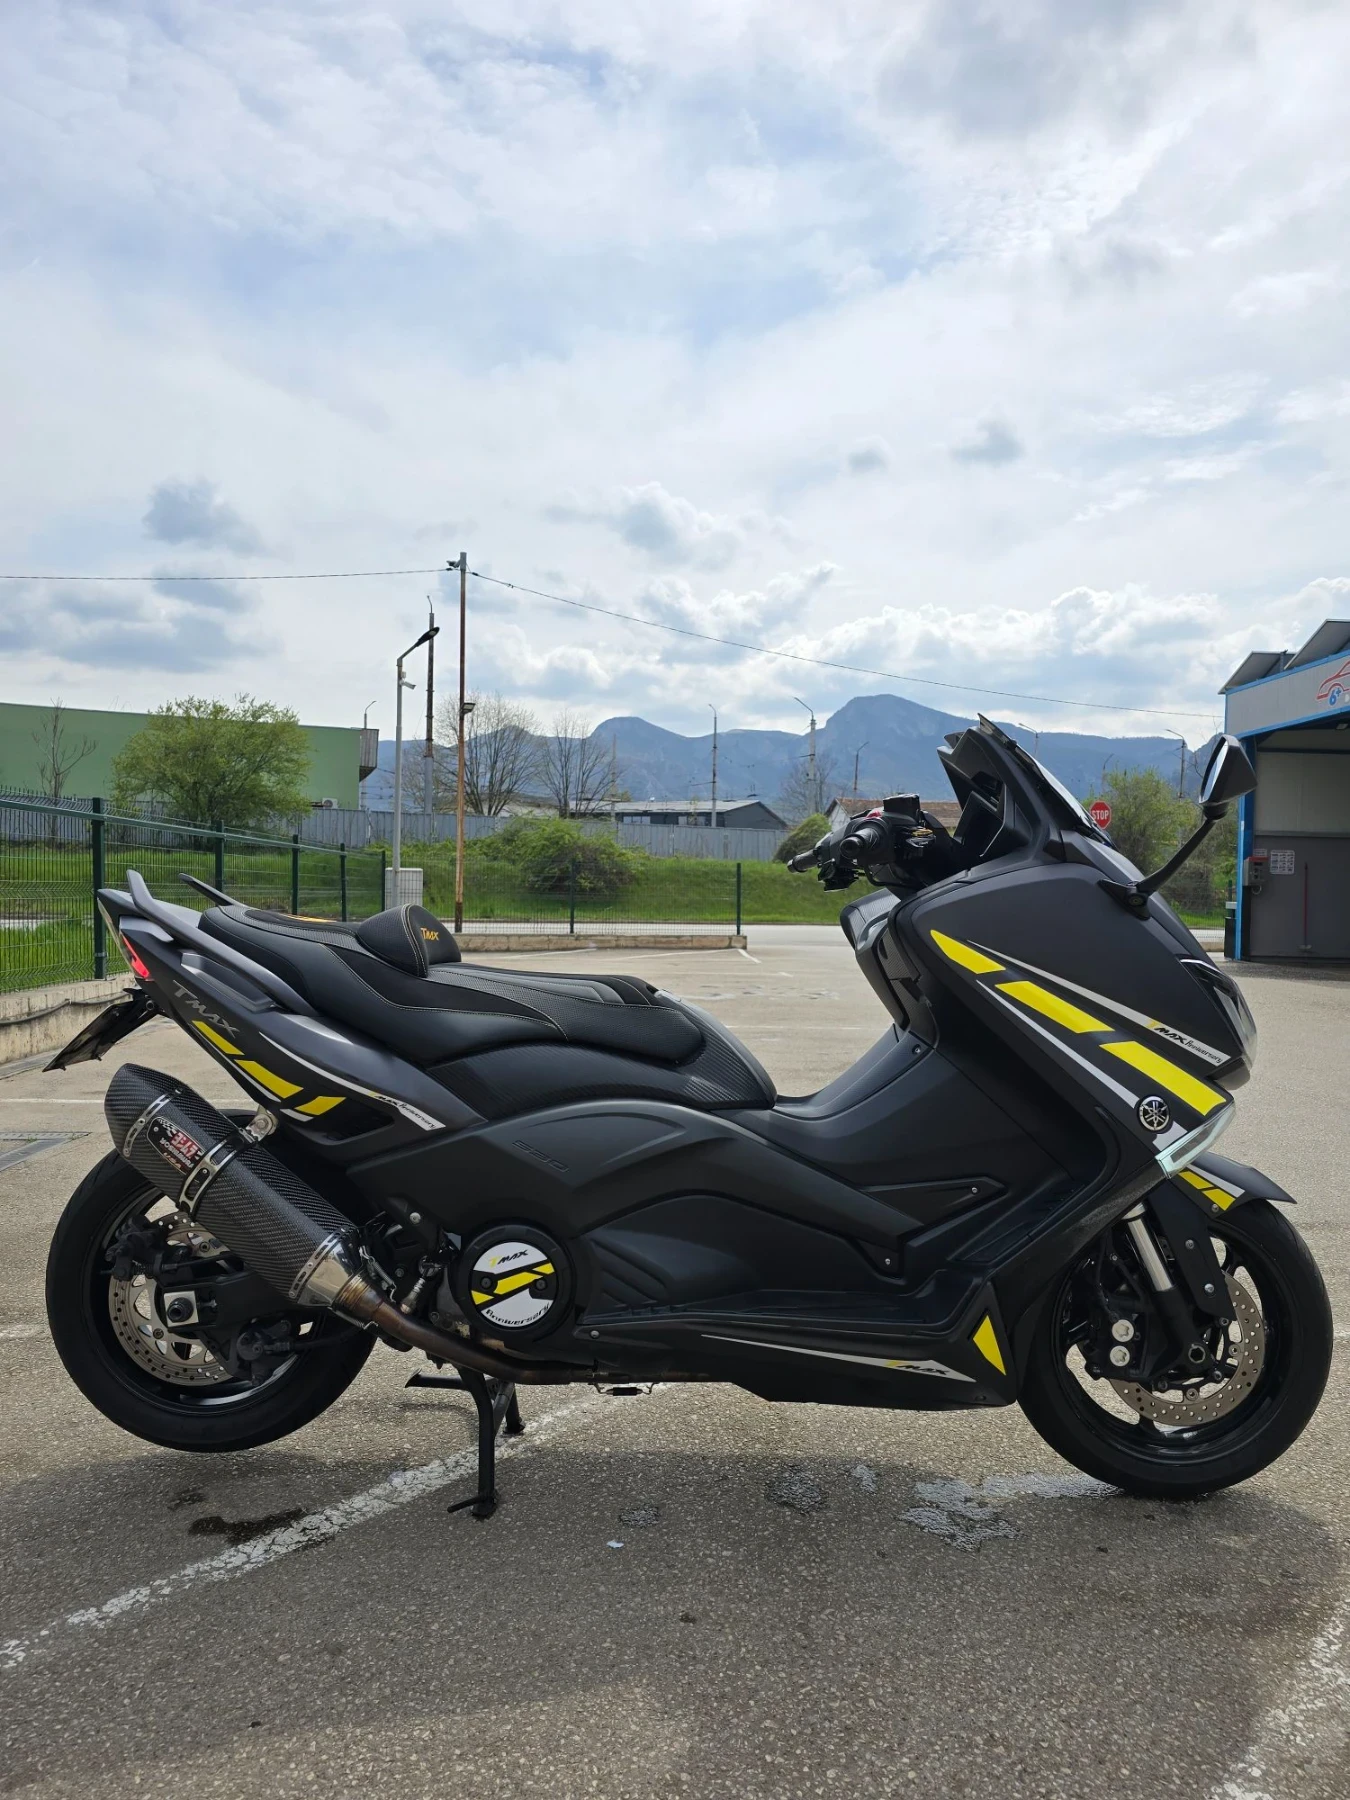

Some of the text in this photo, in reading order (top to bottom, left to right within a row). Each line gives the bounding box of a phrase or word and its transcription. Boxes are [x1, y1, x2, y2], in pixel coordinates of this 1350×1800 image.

[1091, 810, 1109, 820] STOP
[172, 979, 240, 1039] TMAX
[489, 1249, 529, 1269] TMAX
[485, 1302, 550, 1326] Anniversary
